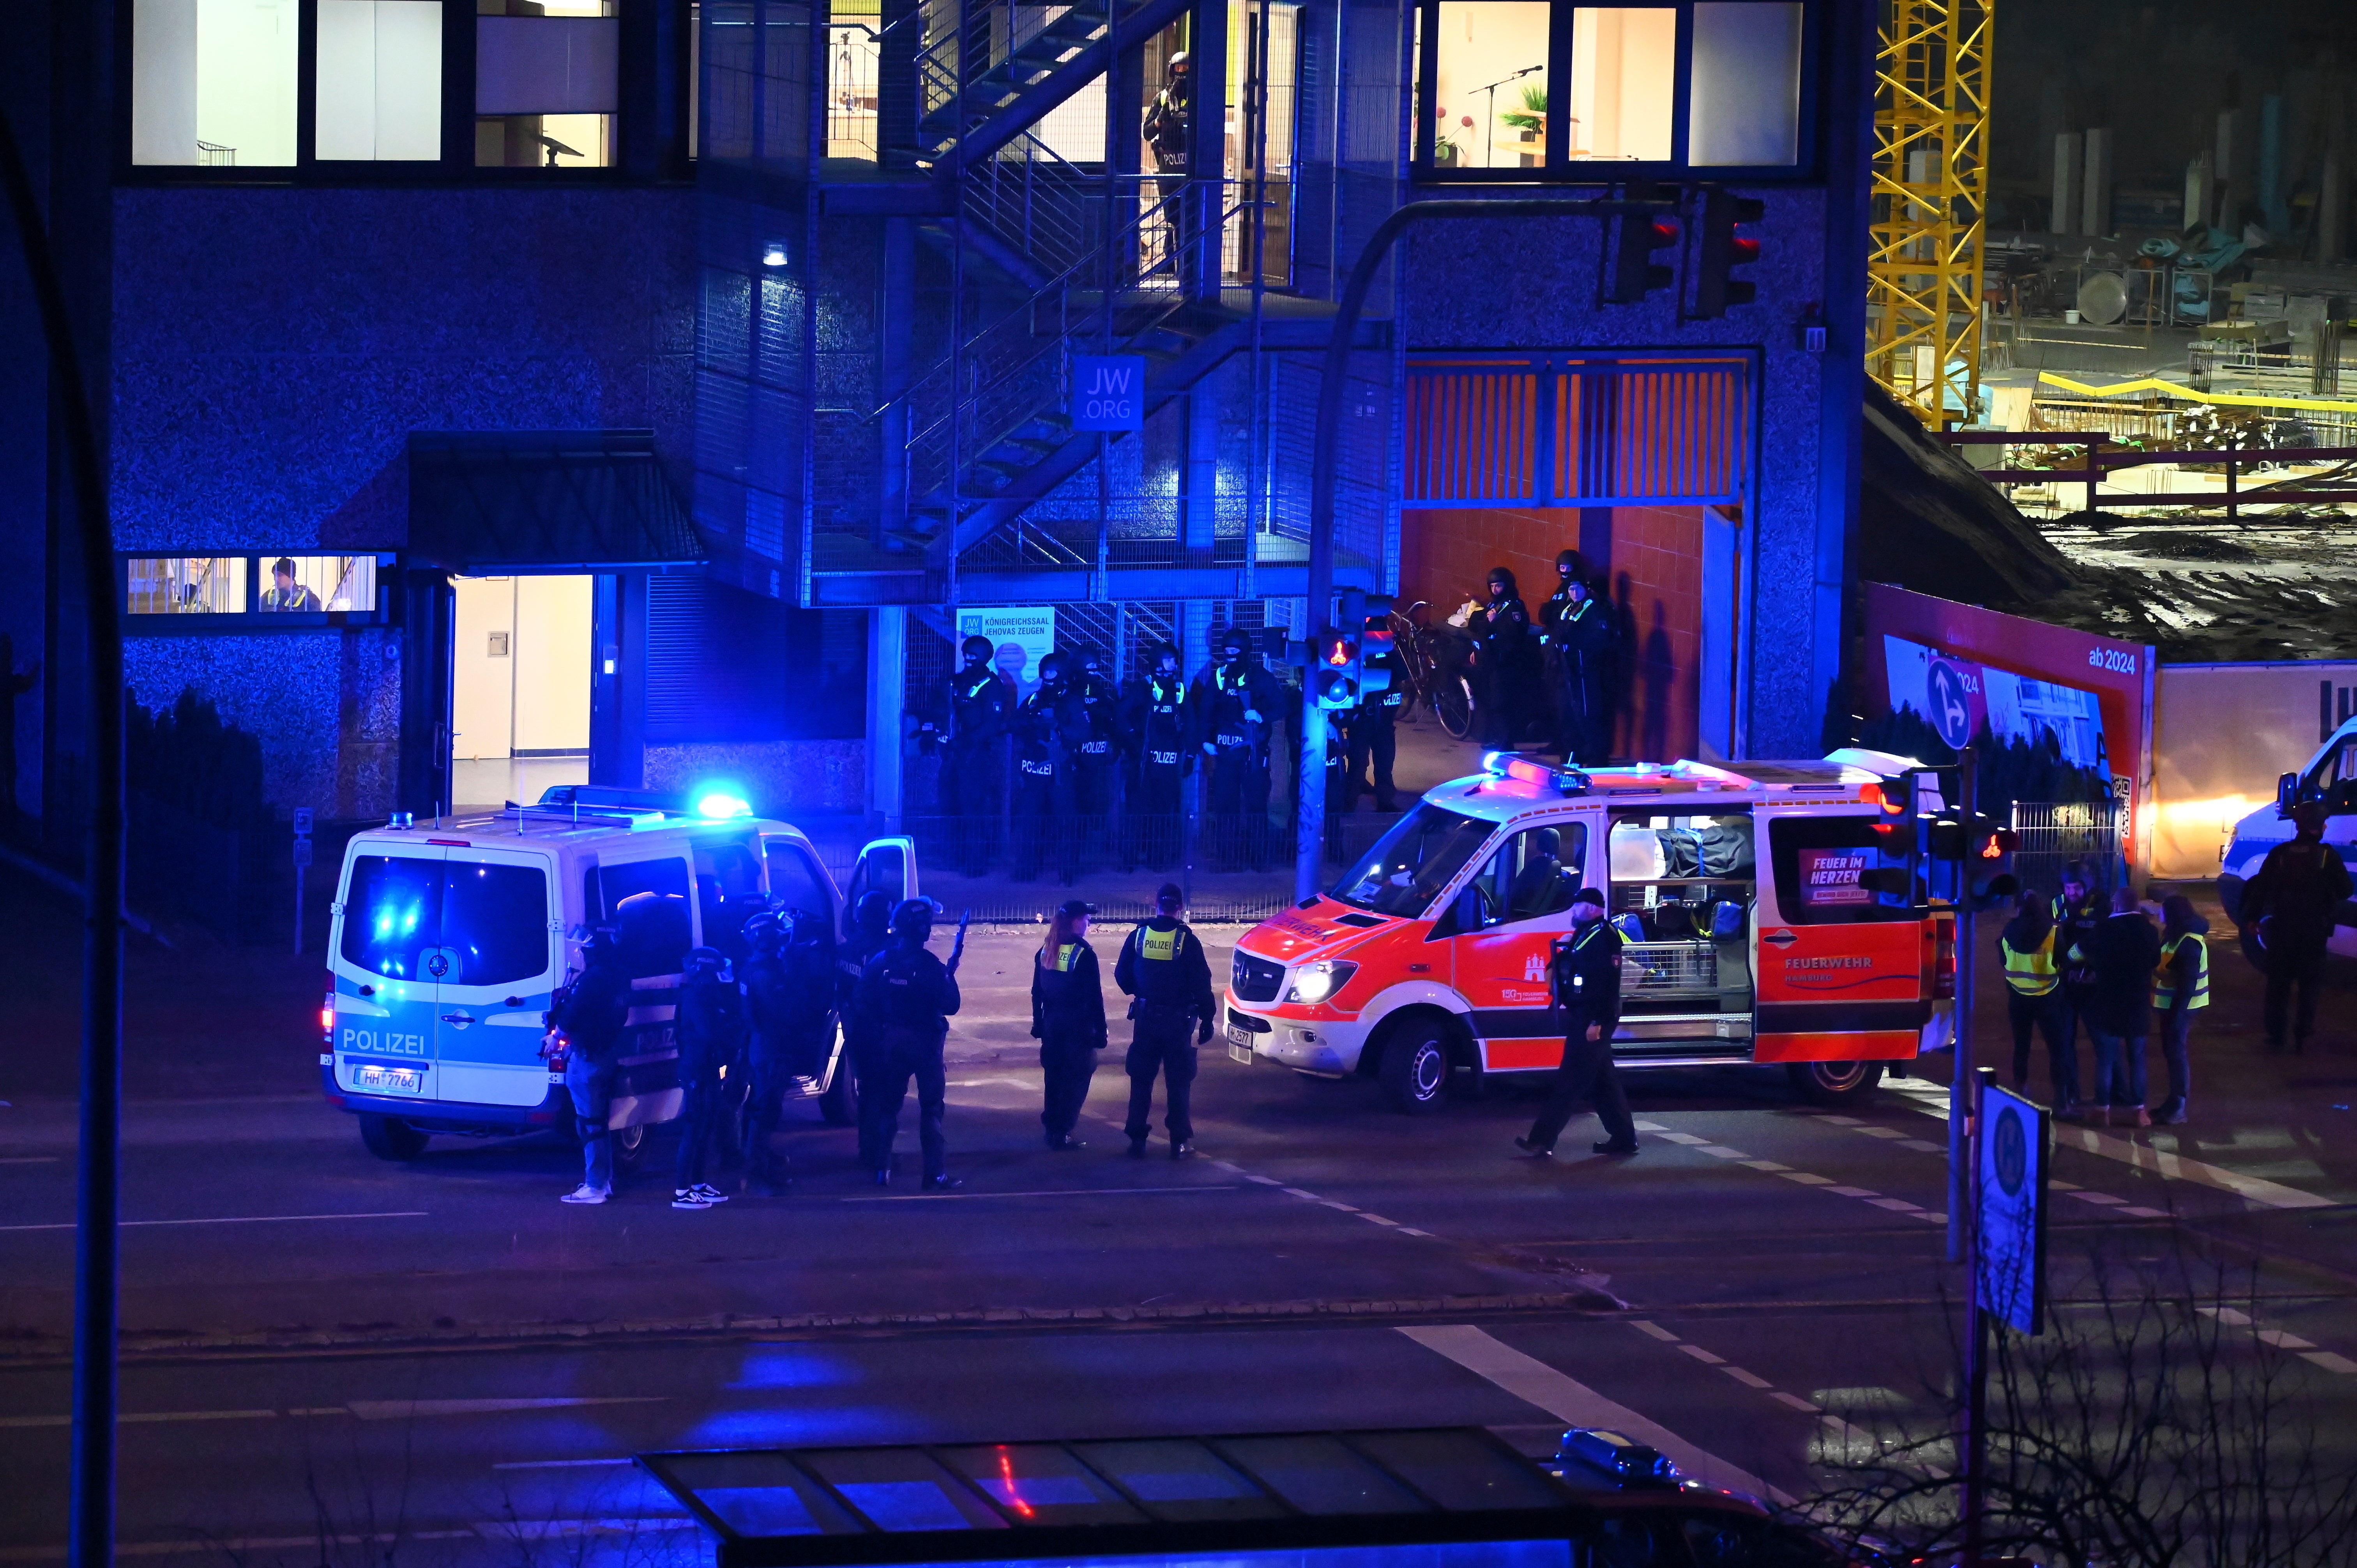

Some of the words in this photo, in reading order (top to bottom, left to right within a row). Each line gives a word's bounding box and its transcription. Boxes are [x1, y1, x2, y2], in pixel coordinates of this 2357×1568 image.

[1164, 153, 1187, 165] POLIZ
[1087, 368, 1131, 395] JW
[965, 618, 979, 627] JW
[985, 617, 1049, 626] KÖNIGREICHSSAAL
[985, 627, 1016, 636] JEHOVAS
[1018, 627, 1044, 635] ZEUGEN
[2089, 647, 2103, 667] ab
[2105, 650, 2135, 675] 2024
[1813, 858, 1847, 869] FEUER
[1849, 857, 1863, 868] IM
[1810, 870, 1860, 885] HERZEN
[1145, 939, 1171, 950] POLIZEI
[1785, 957, 1872, 969] FEUERWEHR
[343, 1029, 424, 1055] POLIZEI
[1236, 1030, 1249, 1044] 2577
[365, 1072, 379, 1084] HH
[388, 1074, 414, 1088] 7766
